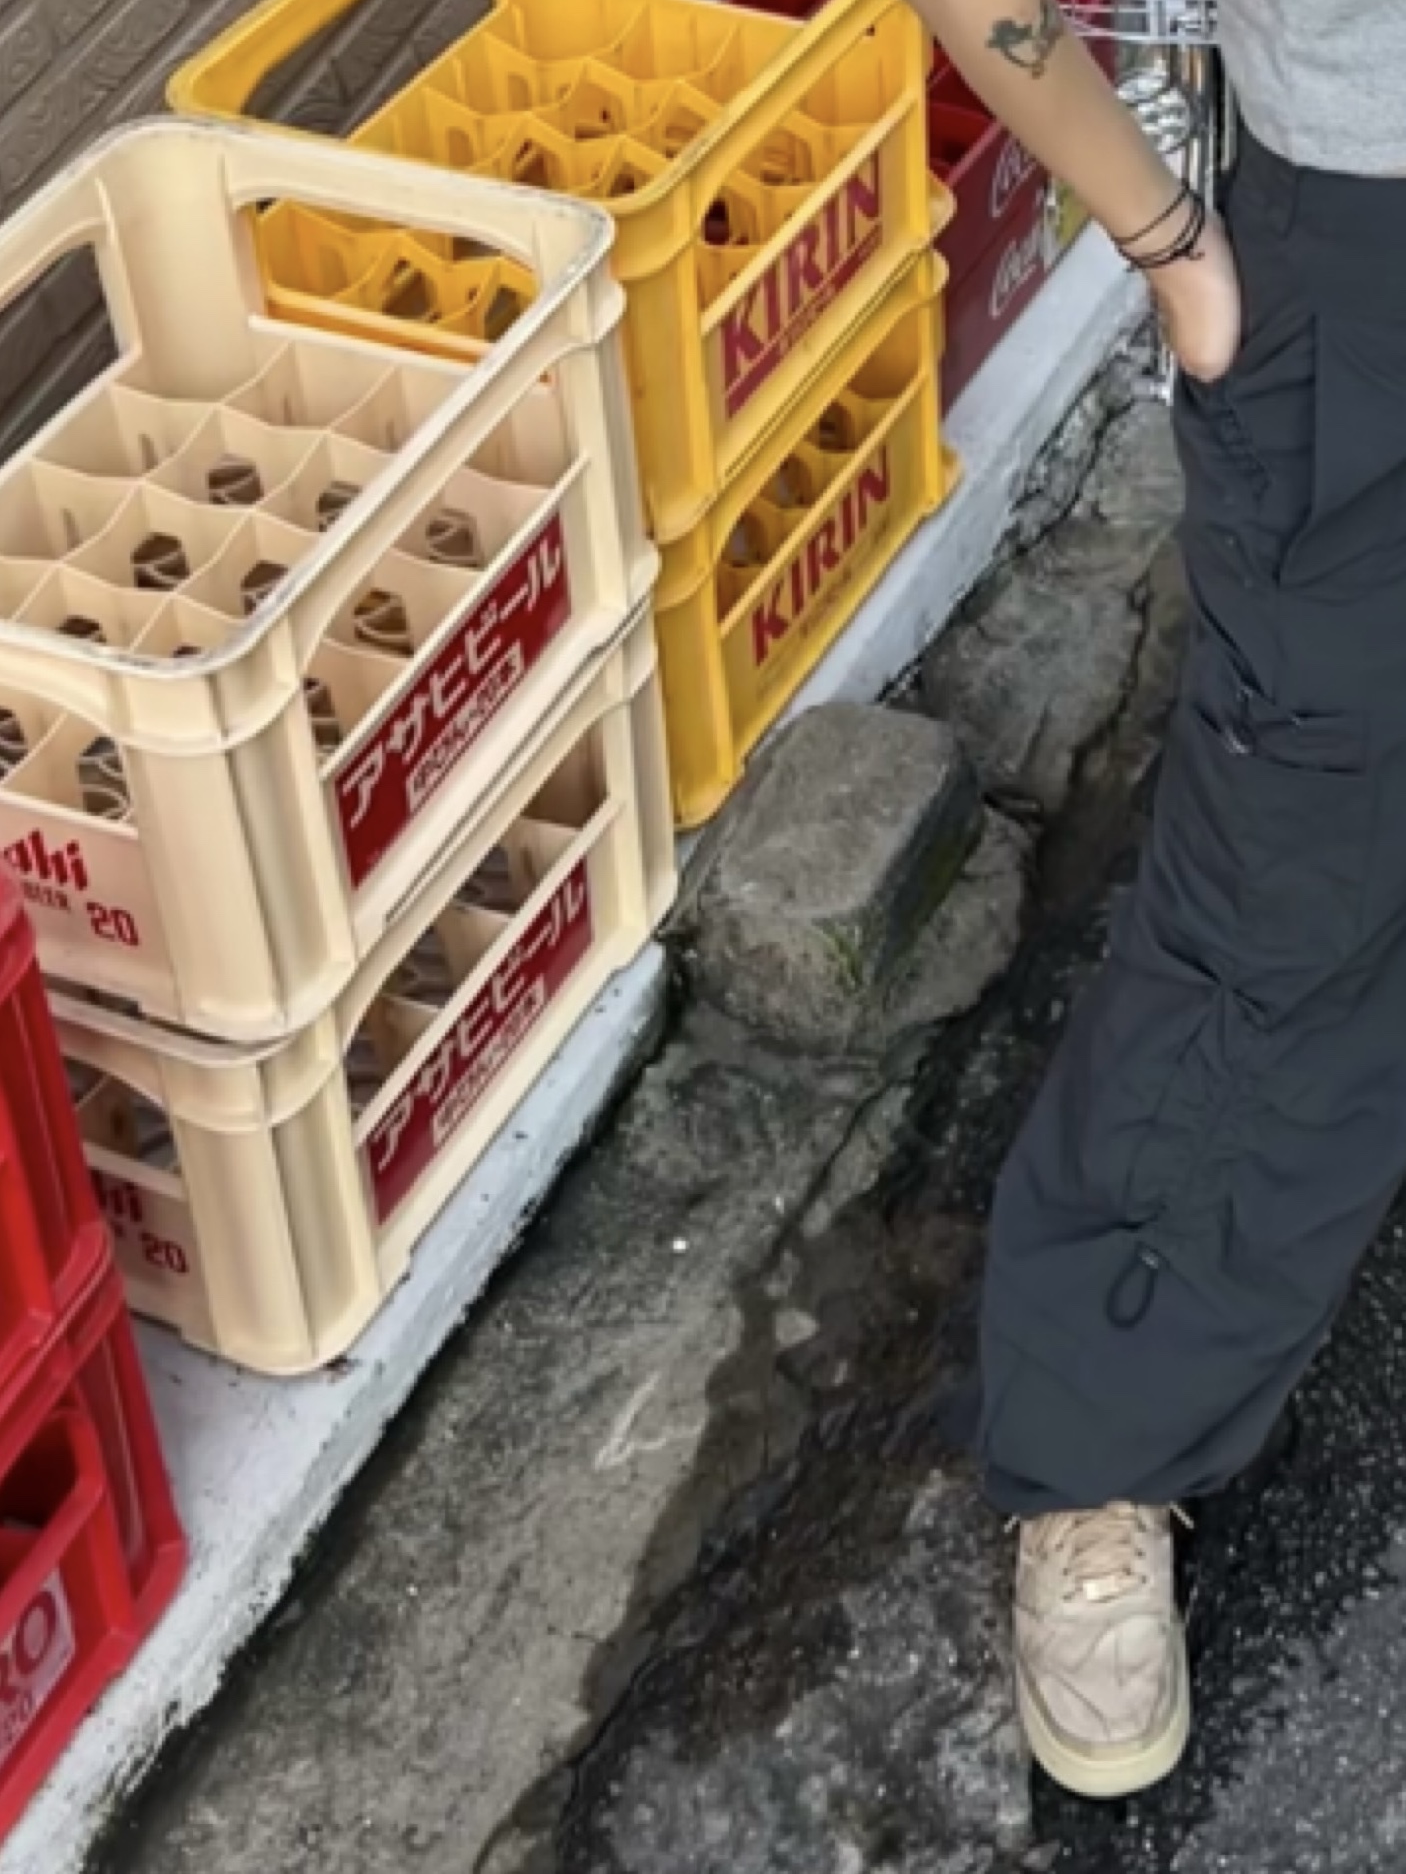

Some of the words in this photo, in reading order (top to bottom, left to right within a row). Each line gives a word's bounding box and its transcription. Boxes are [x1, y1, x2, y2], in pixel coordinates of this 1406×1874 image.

[721, 149, 880, 392] KIRIN
[751, 444, 890, 669] KIRIN
[342, 537, 562, 830] アサヒビール
[2, 826, 88, 892] ahi
[86, 899, 140, 947] 20
[373, 878, 585, 1173] アサヒビール
[139, 1230, 190, 1276] 20
